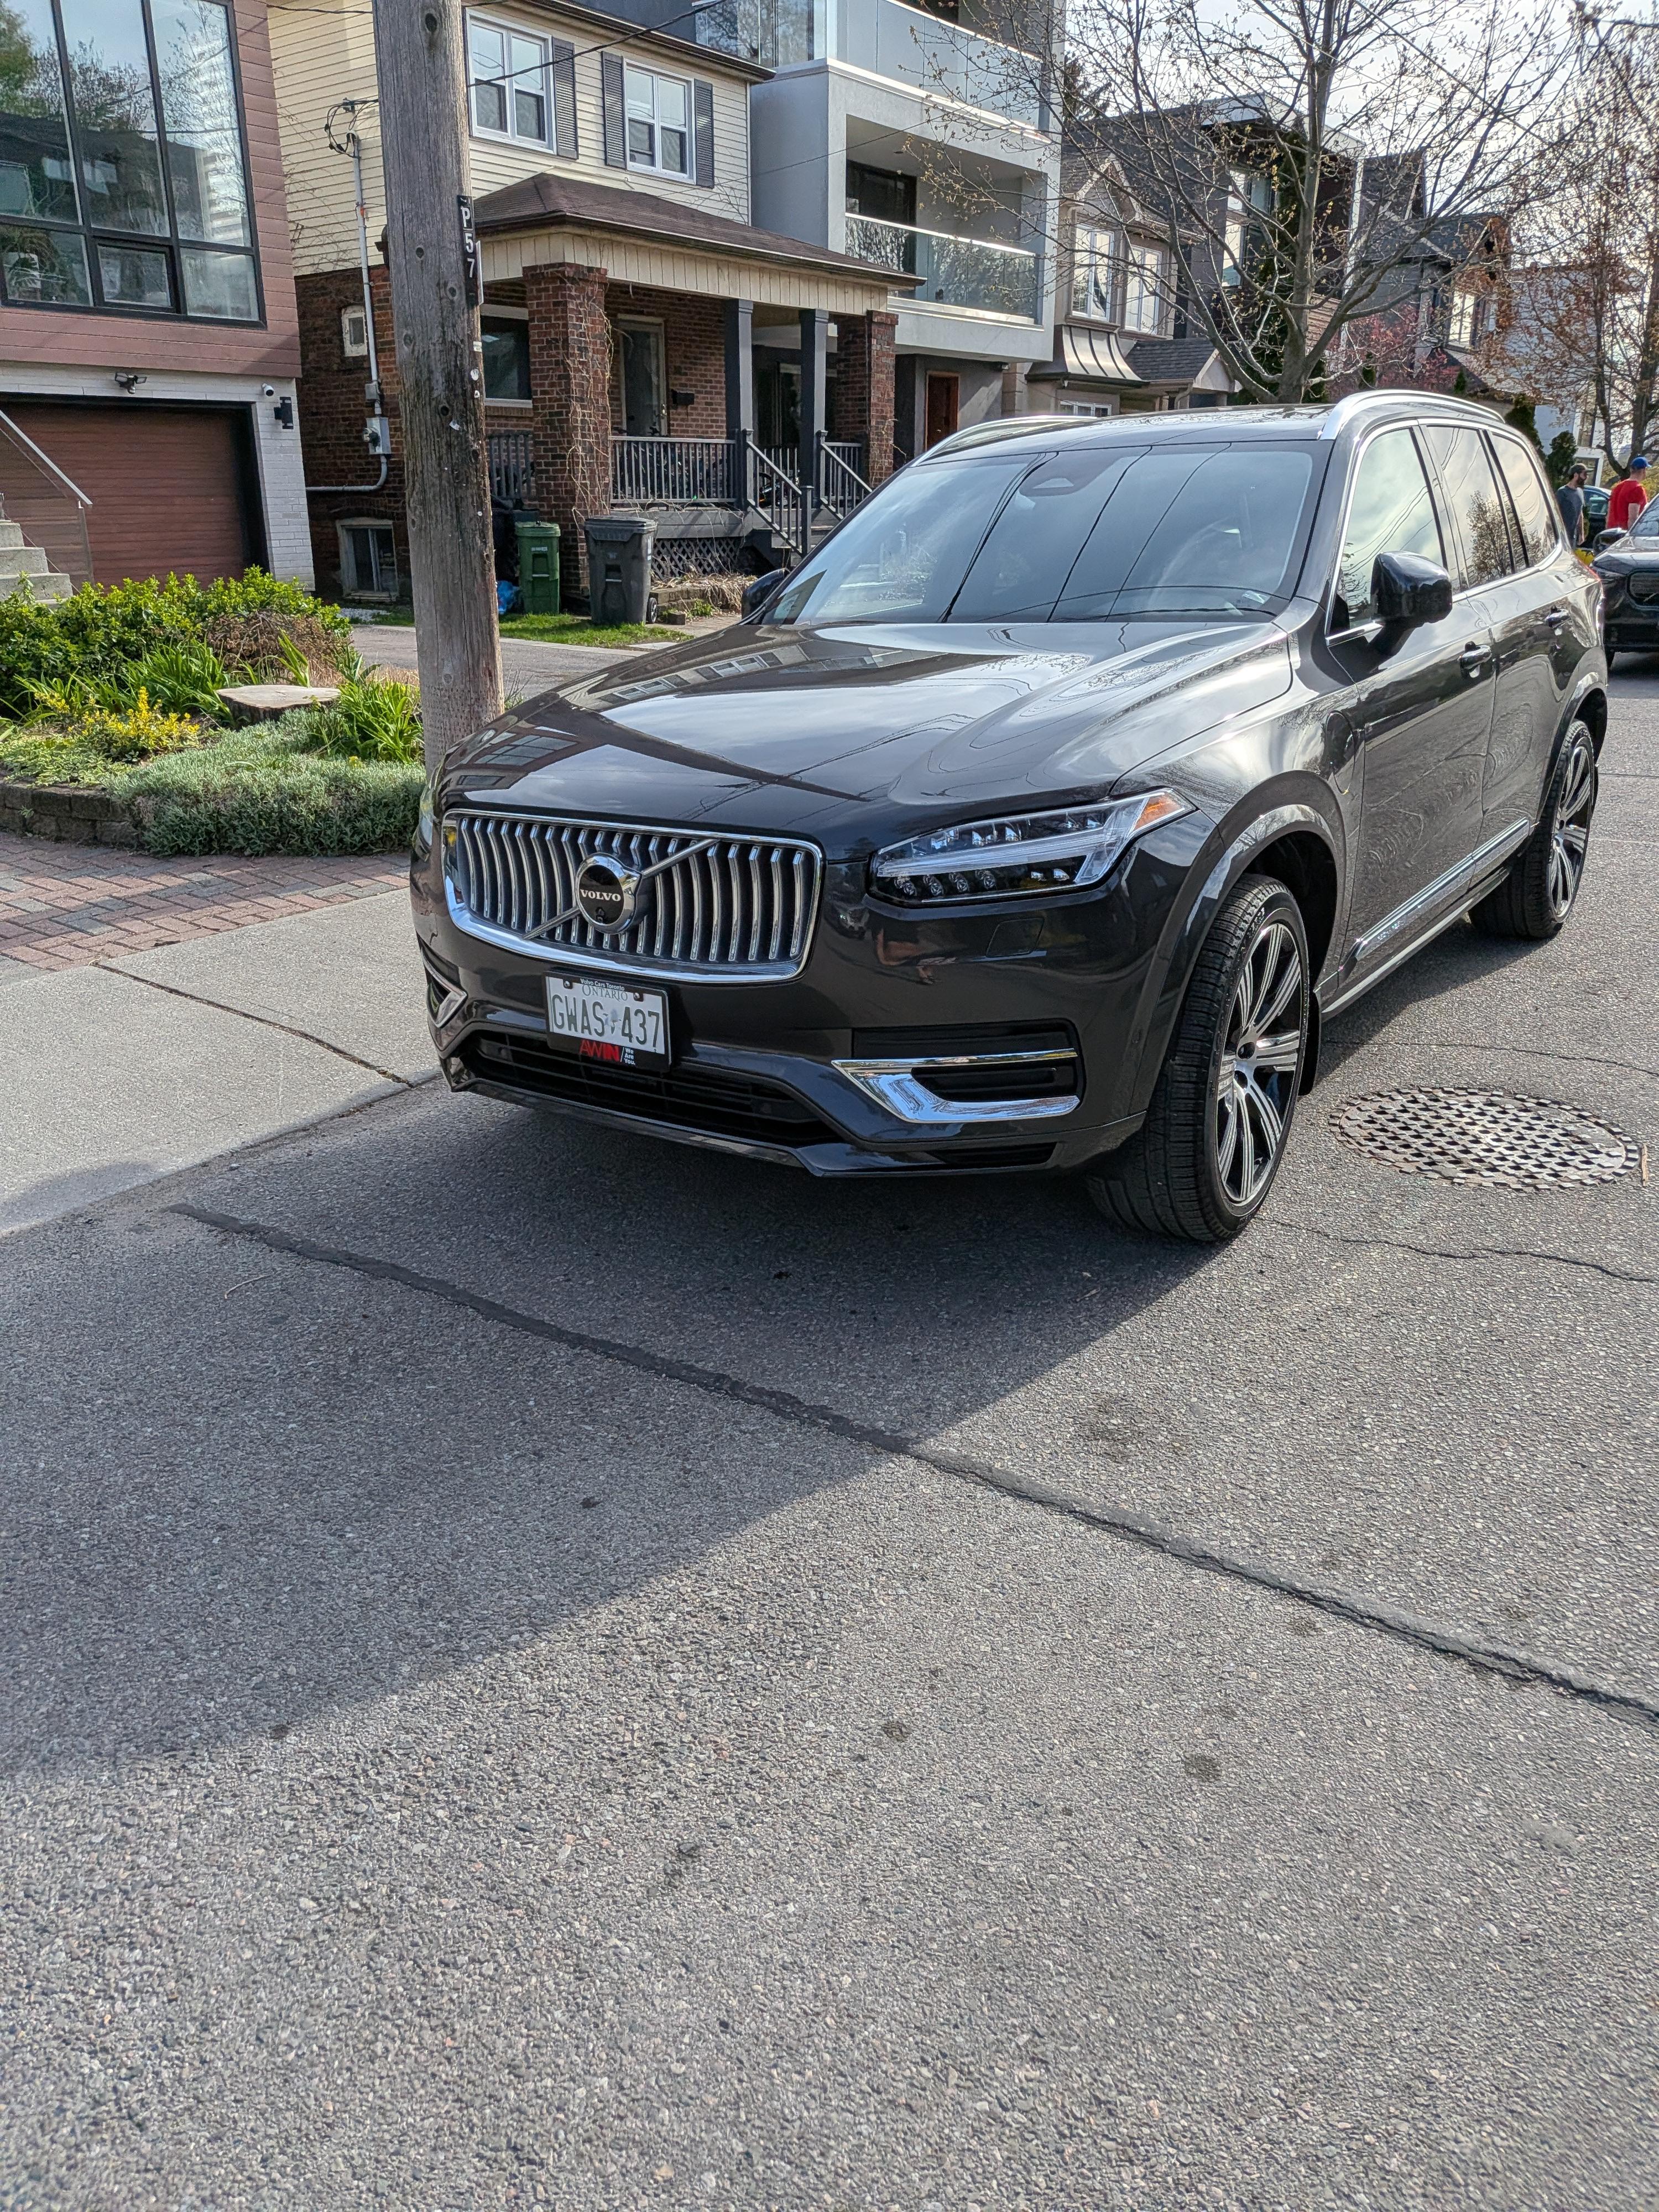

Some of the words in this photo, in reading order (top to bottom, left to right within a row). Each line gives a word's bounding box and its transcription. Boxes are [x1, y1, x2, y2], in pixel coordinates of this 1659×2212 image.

[580, 889, 621, 901] VOLVO
[582, 984, 628, 1001] ONTARIO
[552, 994, 604, 1036] GWAS
[622, 1006, 659, 1047] 437
[580, 1040, 619, 1061] AWIN
